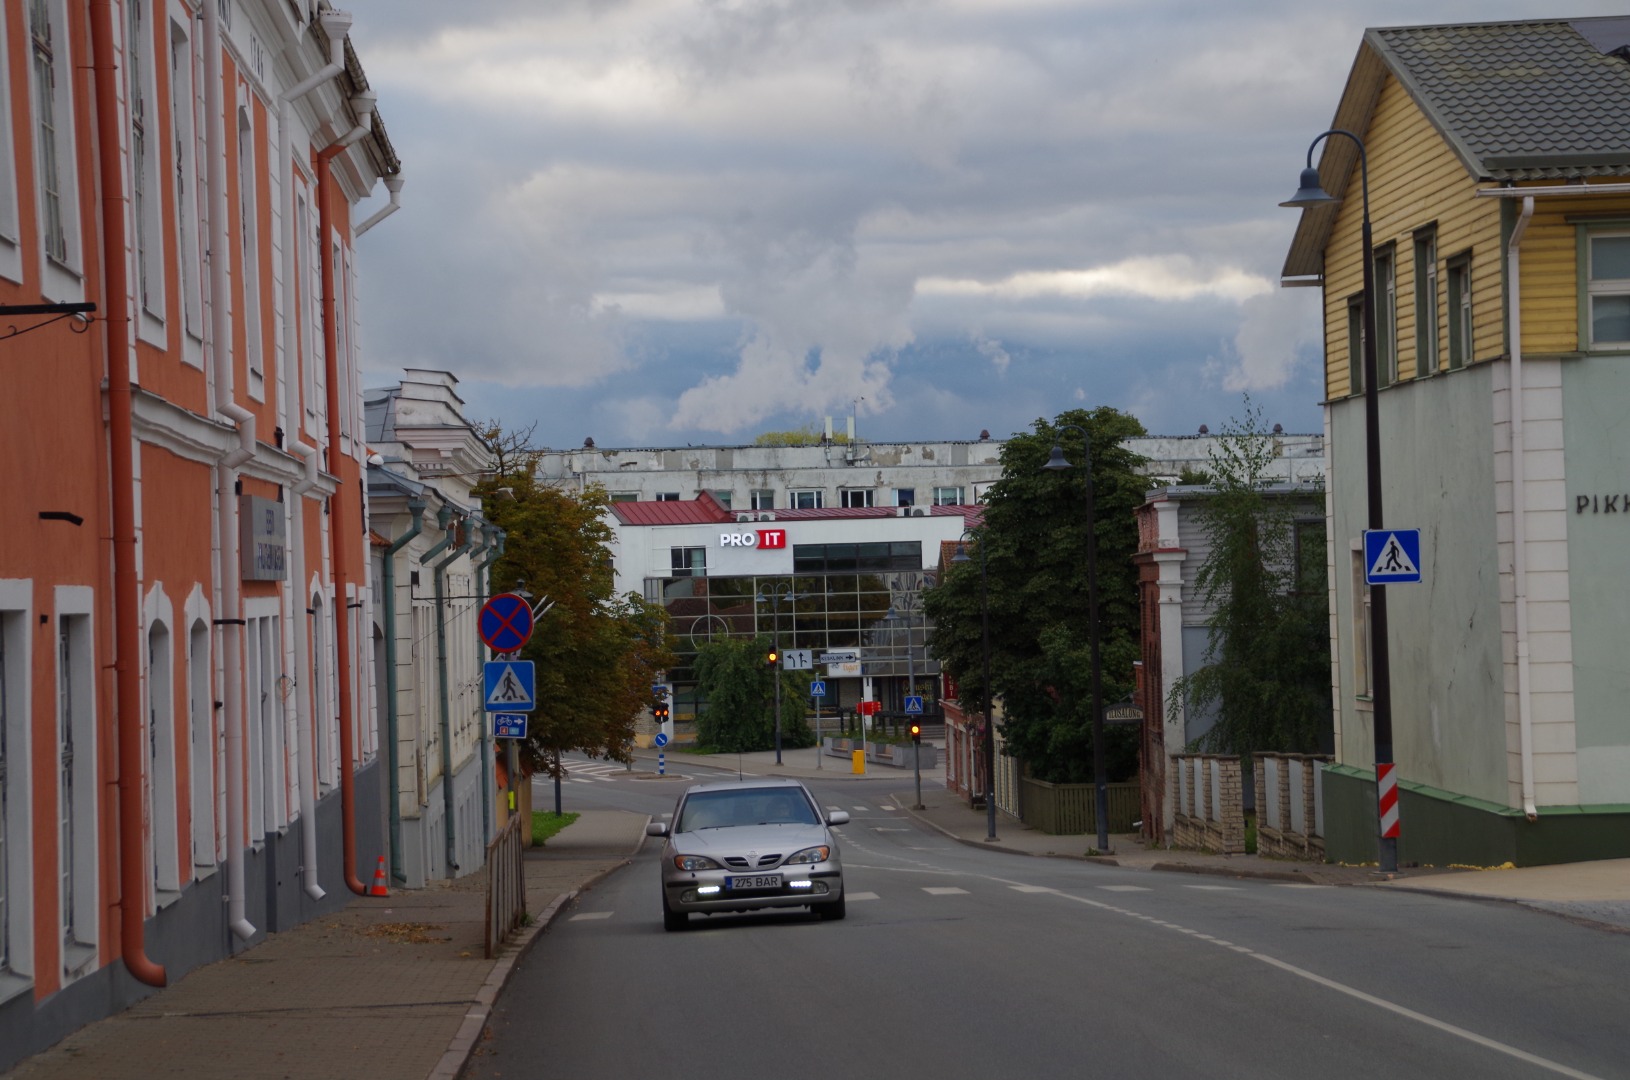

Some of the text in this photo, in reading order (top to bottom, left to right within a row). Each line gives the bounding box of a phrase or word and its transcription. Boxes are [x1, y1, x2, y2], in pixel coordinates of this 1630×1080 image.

[720, 532, 781, 547] PRO IT
[735, 878, 752, 888] 275
[755, 876, 778, 887] BAR
